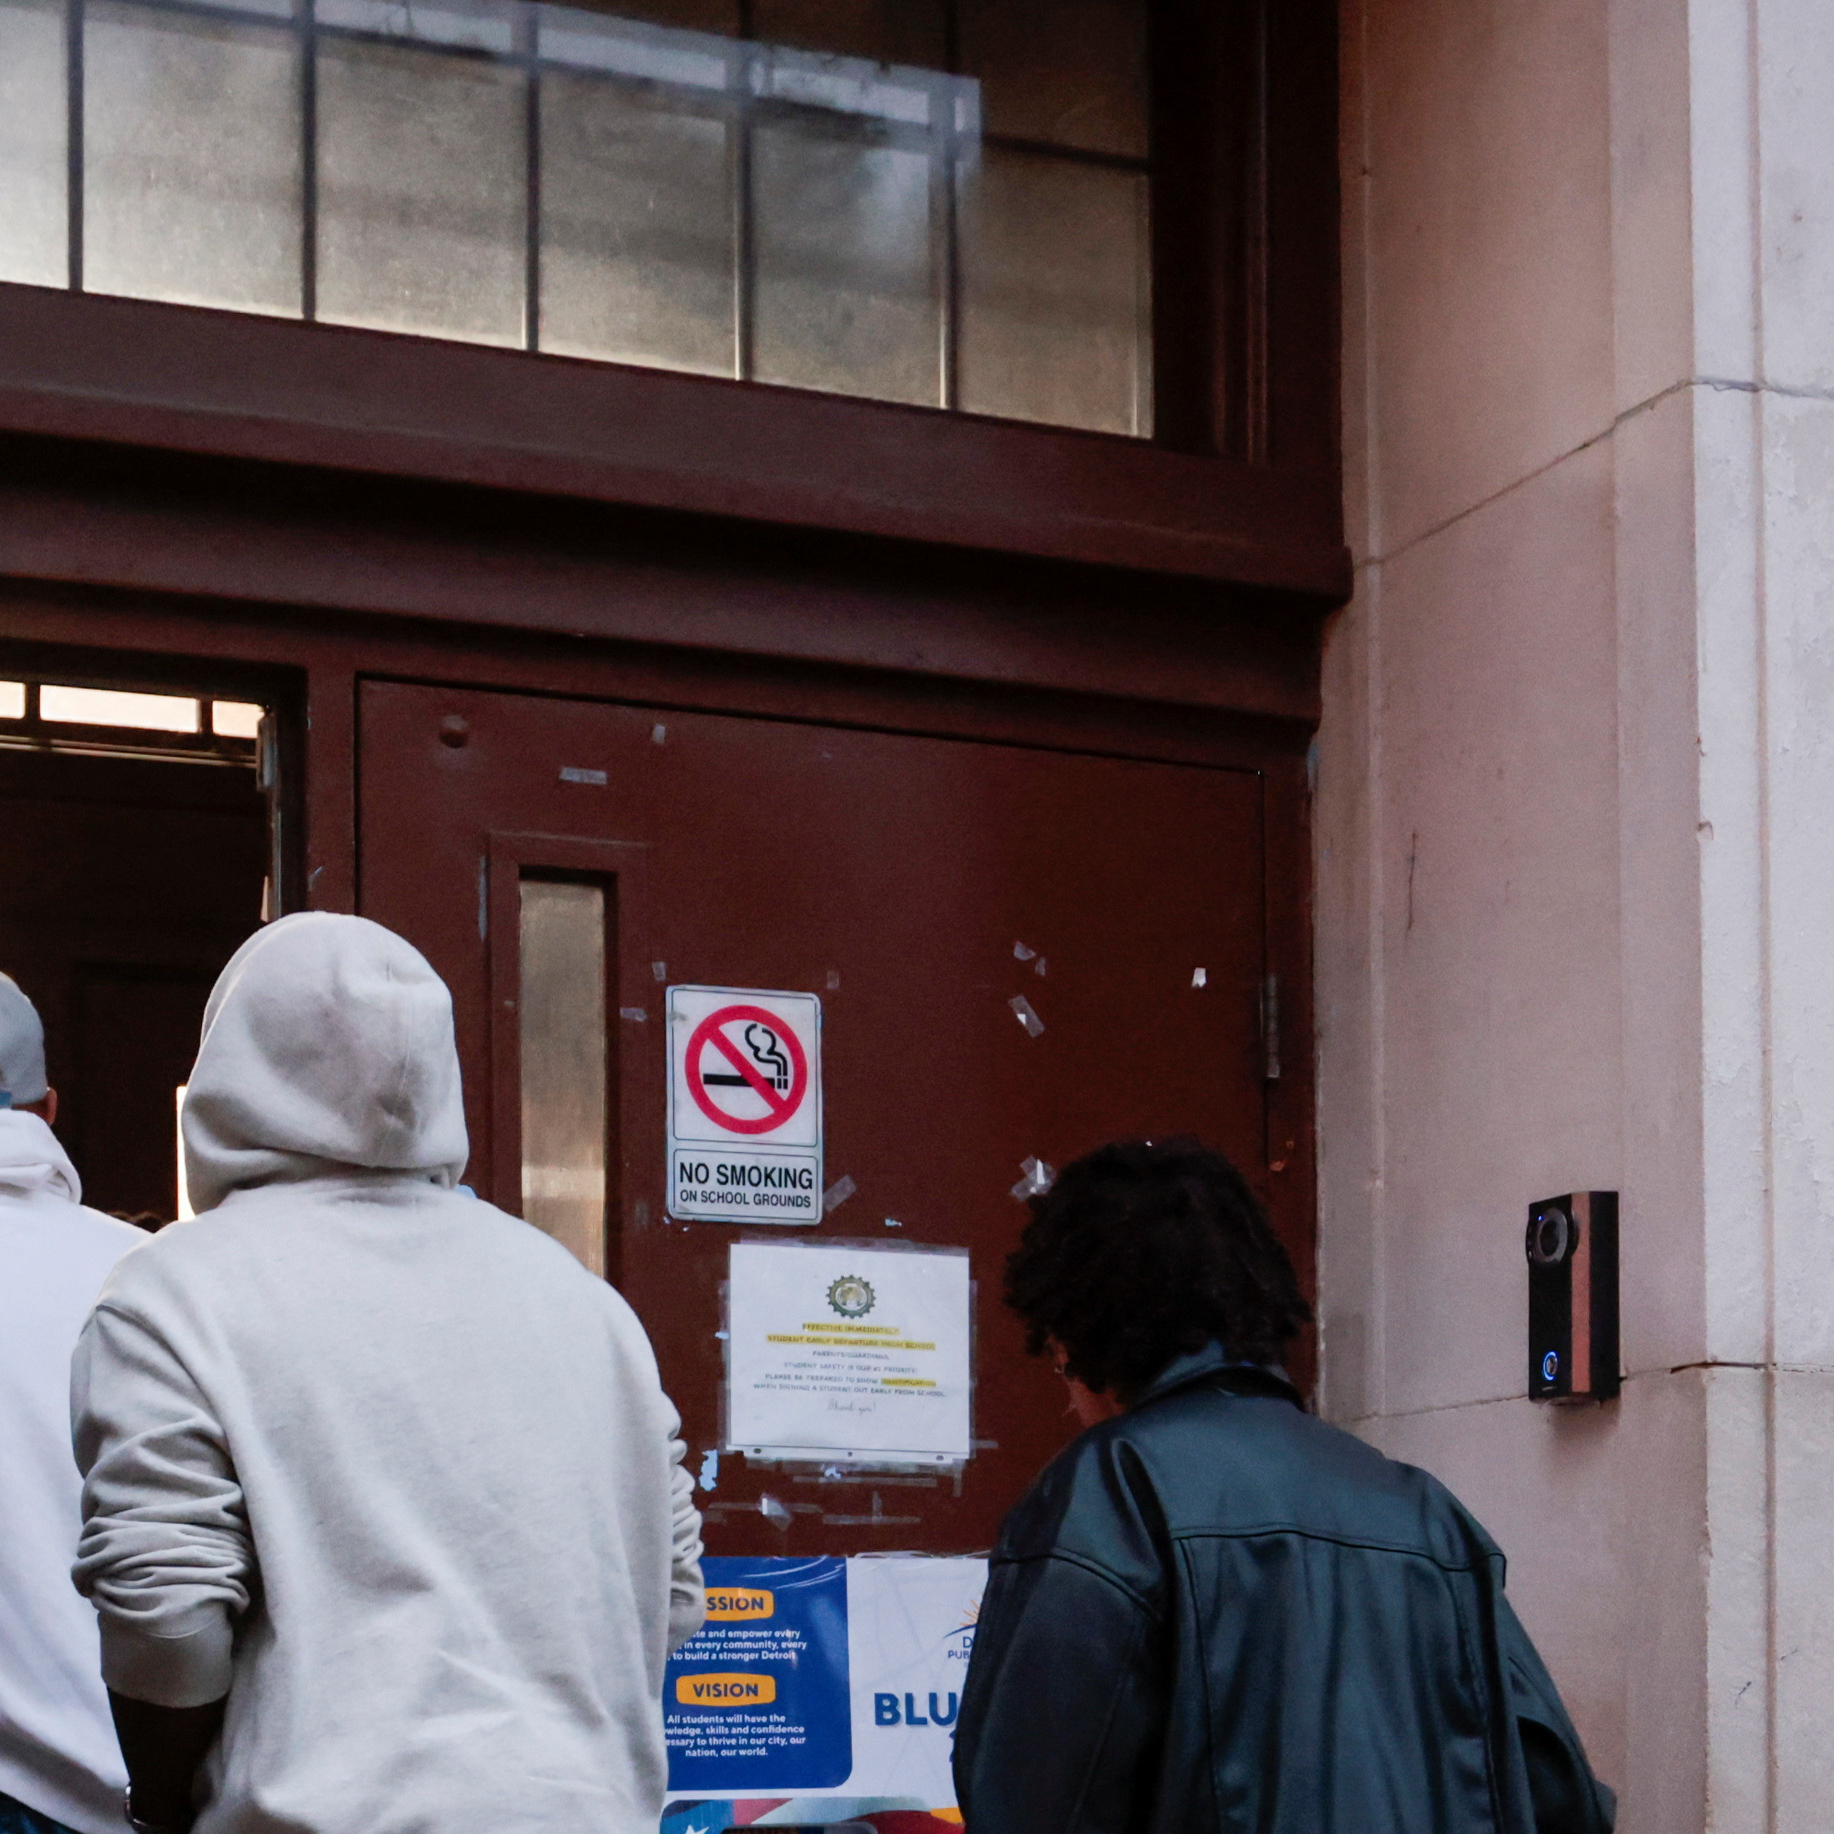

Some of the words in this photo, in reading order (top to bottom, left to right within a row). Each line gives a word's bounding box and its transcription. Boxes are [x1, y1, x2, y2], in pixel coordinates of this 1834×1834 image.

[680, 1162, 709, 1185] NO
[716, 1163, 813, 1190] SMOKING
[680, 1189, 697, 1202] ON
[701, 1190, 749, 1206] SCHOOL
[753, 1193, 811, 1208] GROUNDS
[767, 1335, 804, 1343] STUDENT
[784, 1361, 817, 1369] STUDENT
[765, 1373, 791, 1381] PLEASE
[806, 1374, 843, 1383] PREPARED
[779, 1383, 809, 1392] SIGNING
[819, 1385, 851, 1393] STUDENT
[894, 1388, 915, 1396] FROM
[707, 1597, 764, 1611] SSION
[708, 1629, 726, 1638] and
[728, 1630, 772, 1641] empower
[774, 1629, 800, 1641] every
[684, 1640, 693, 1649] in
[695, 1642, 721, 1652] every
[781, 1641, 808, 1651] every
[673, 1652, 682, 1660] to
[684, 1651, 709, 1660] build
[719, 1652, 759, 1662] stronger
[693, 1683, 759, 1698] VISION
[874, 1692, 957, 1727] BLU
[667, 1714, 680, 1723] All
[682, 1714, 724, 1723] students
[726, 1714, 743, 1723] will
[744, 1714, 767, 1723] have
[770, 1713, 786, 1723] the
[706, 1725, 729, 1735] skills
[731, 1724, 749, 1734] and
[751, 1724, 805, 1734] confidence
[665, 1738, 694, 1748] essary
[697, 1737, 707, 1746] to
[709, 1737, 737, 1746] thrive
[738, 1736, 747, 1745] in
[749, 1737, 766, 1746] our
[768, 1736, 788, 1747] city,
[790, 1736, 806, 1745] our
[685, 1748, 719, 1759] nation,
[720, 1748, 737, 1757] our
[738, 1746, 768, 1757] world.
